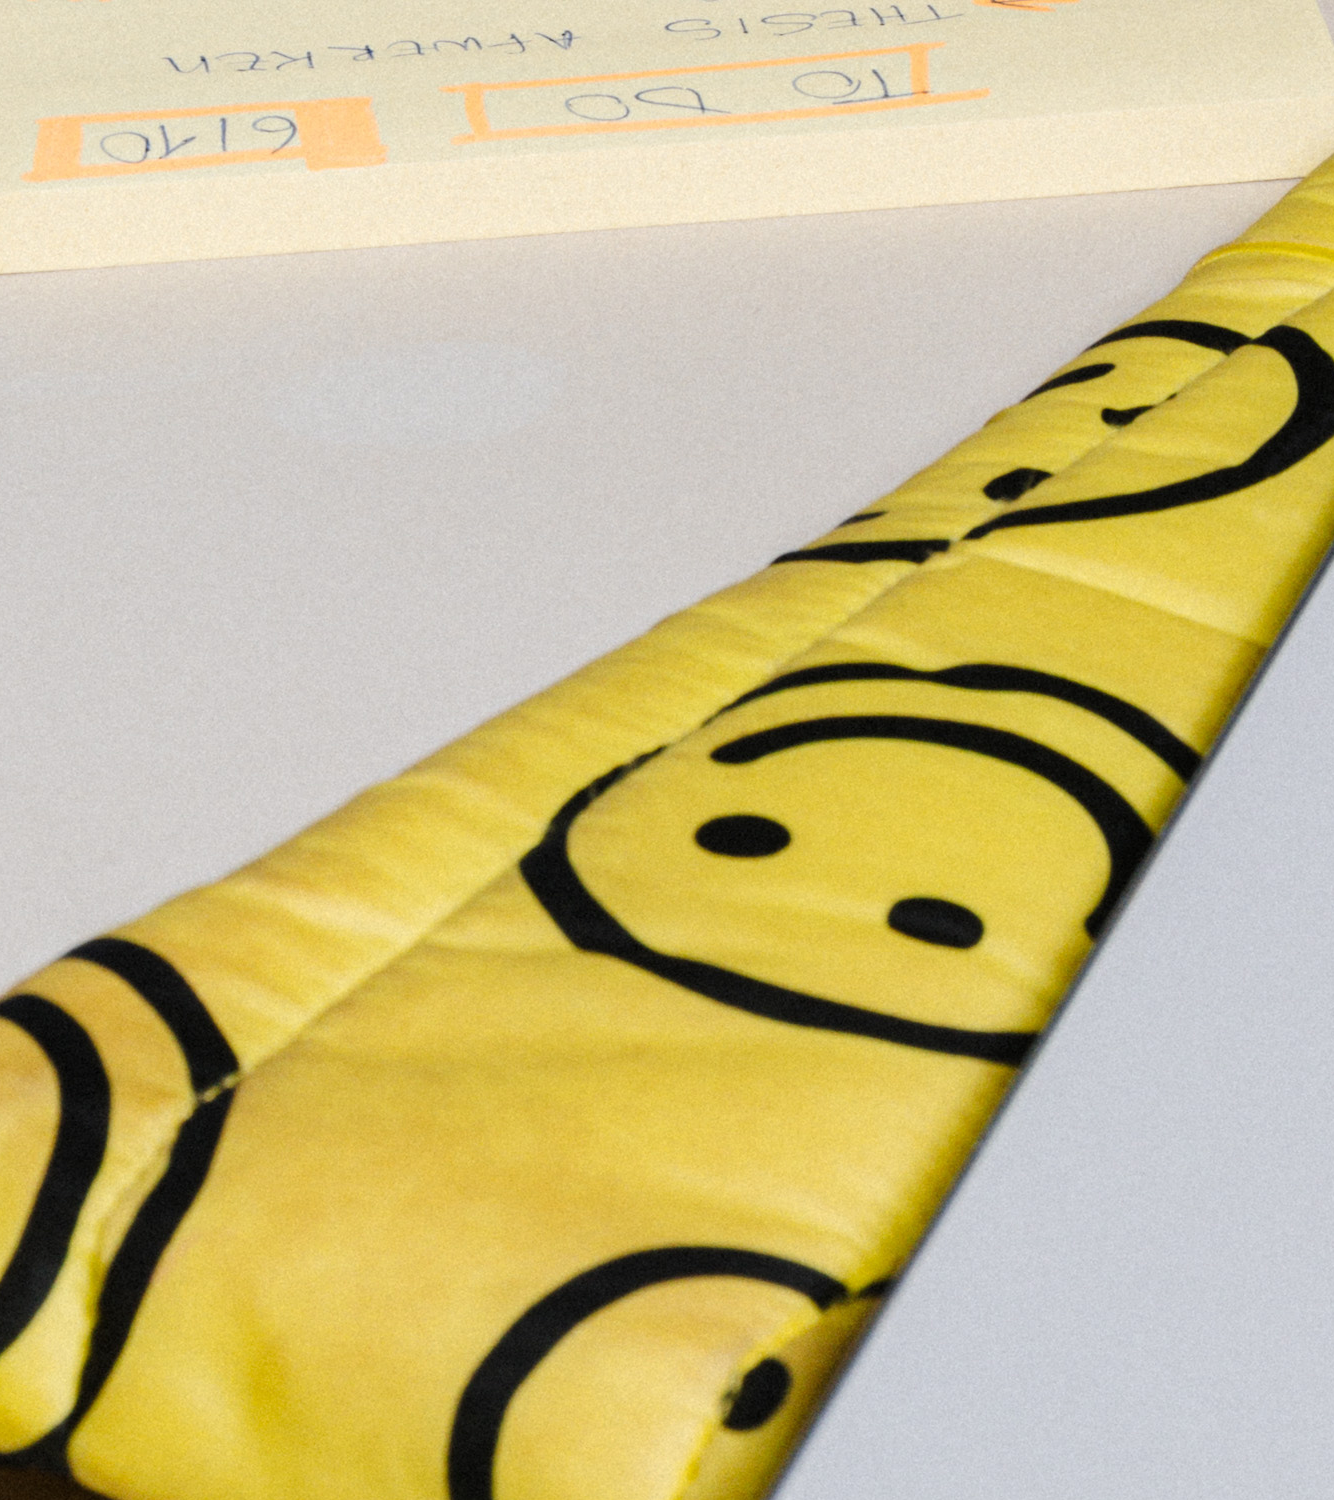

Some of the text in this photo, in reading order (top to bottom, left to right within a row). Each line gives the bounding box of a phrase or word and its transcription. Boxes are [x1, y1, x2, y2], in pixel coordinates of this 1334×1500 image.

[665, 4, 964, 40] THESIS
[565, 86, 731, 121] DO
[792, 68, 930, 104] TO
